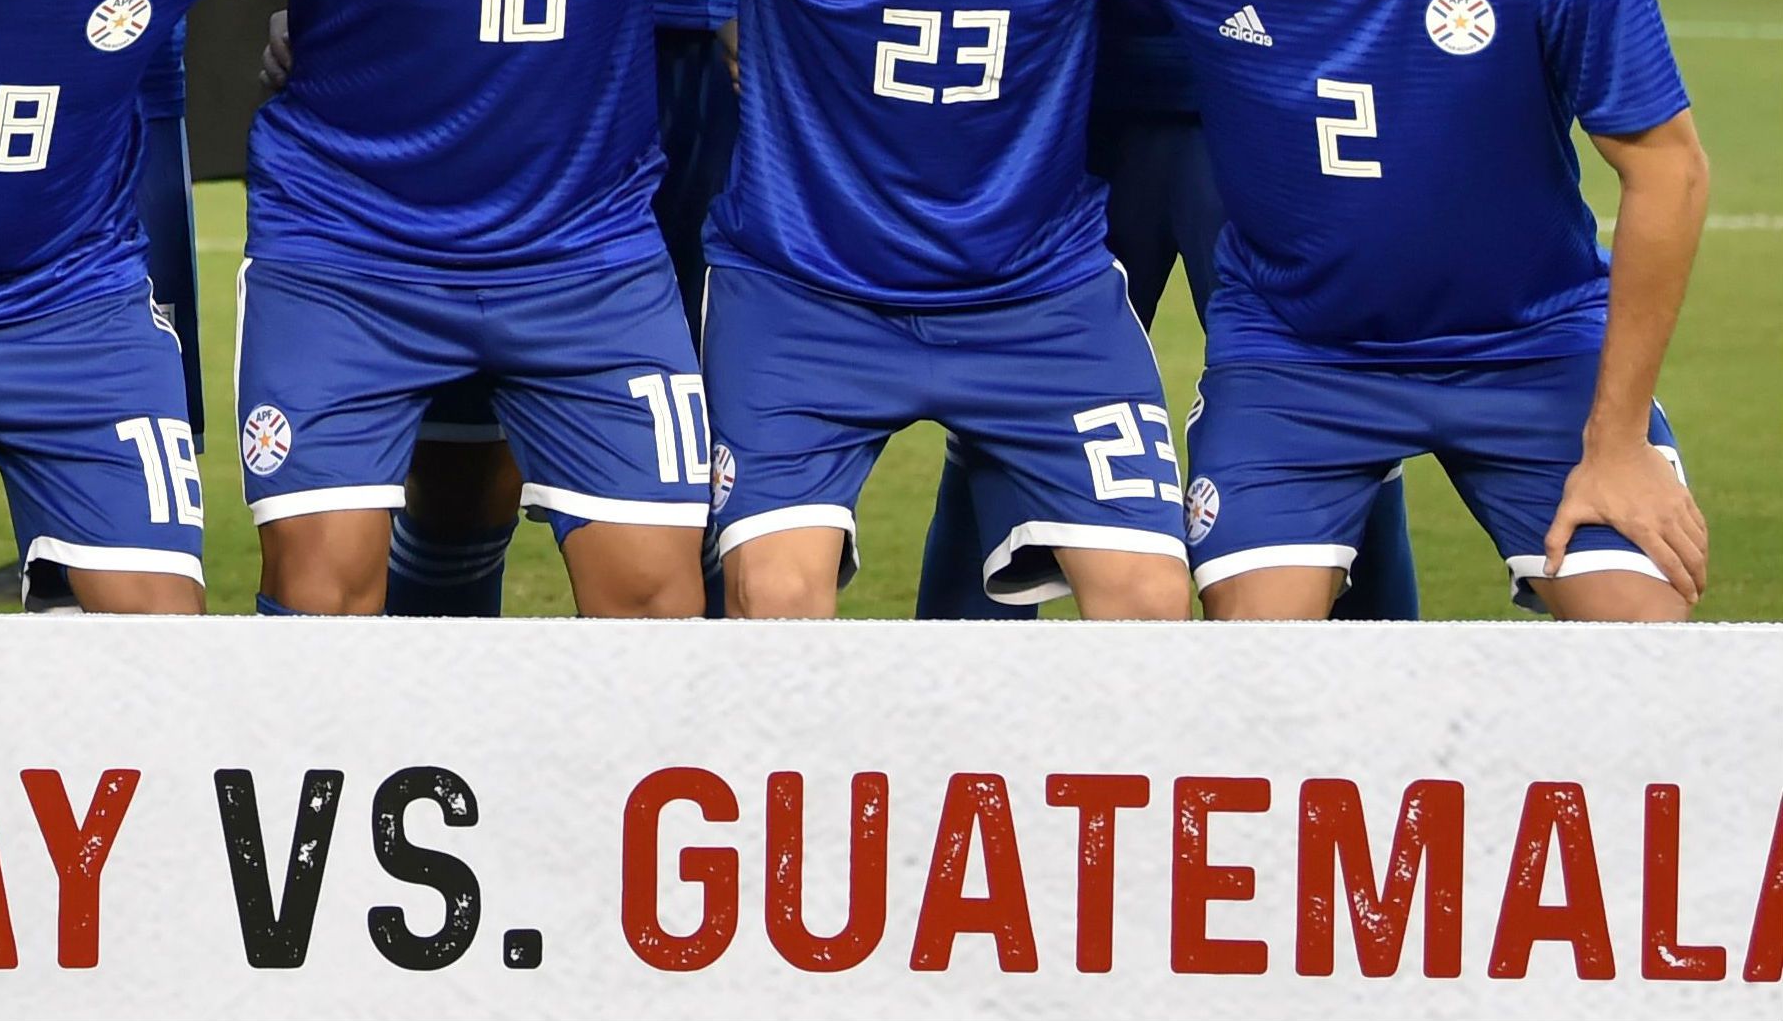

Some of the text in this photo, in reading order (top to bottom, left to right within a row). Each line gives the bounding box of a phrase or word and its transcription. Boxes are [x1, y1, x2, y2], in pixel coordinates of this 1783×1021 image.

[873, 8, 1010, 104] 23
[1218, 24, 1273, 47] adidas
[1316, 78, 1383, 178] 2
[256, 409, 272, 423] APF
[628, 373, 711, 484] 10
[1073, 401, 1184, 505] 23
[115, 416, 204, 529] 18
[214, 765, 543, 972] VS.
